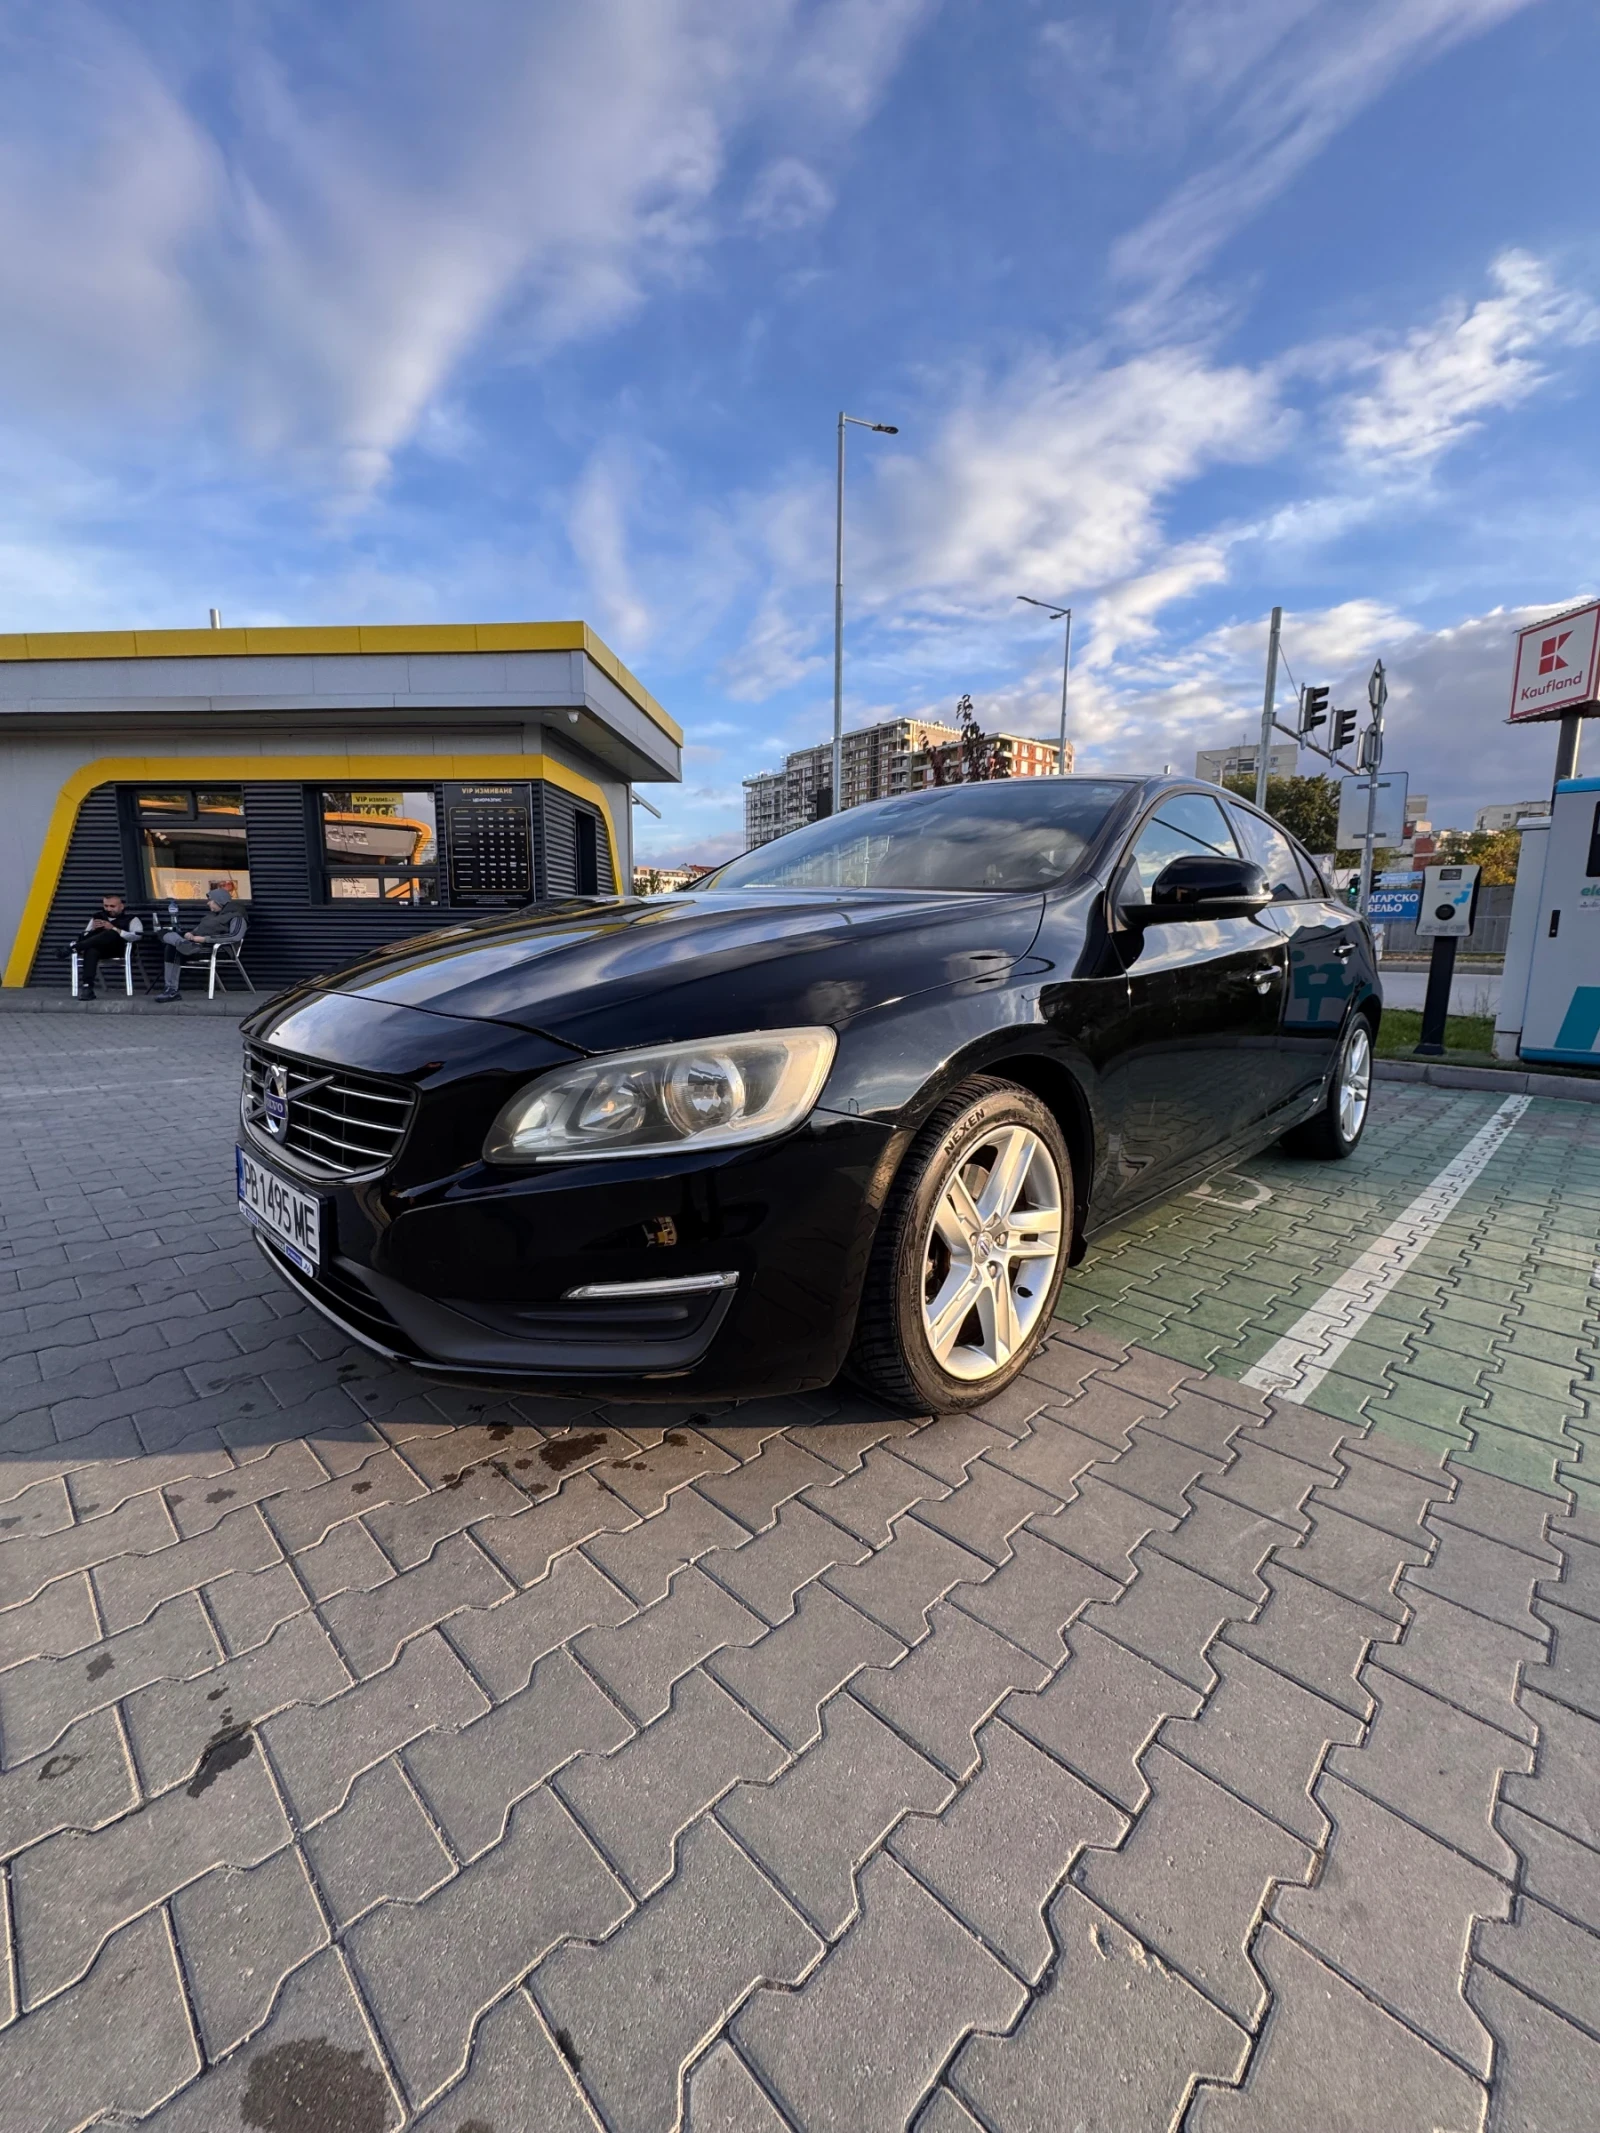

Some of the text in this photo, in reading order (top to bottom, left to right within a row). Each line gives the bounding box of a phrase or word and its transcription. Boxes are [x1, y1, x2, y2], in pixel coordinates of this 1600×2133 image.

[1521, 671, 1582, 700] Kaufland
[360, 807, 395, 817] КАСА
[1367, 903, 1403, 912] БЕЛЬО
[943, 1108, 985, 1156] NEXEN
[244, 1158, 259, 1205] PB
[260, 1172, 292, 1234] 1495
[293, 1196, 317, 1255] ME
